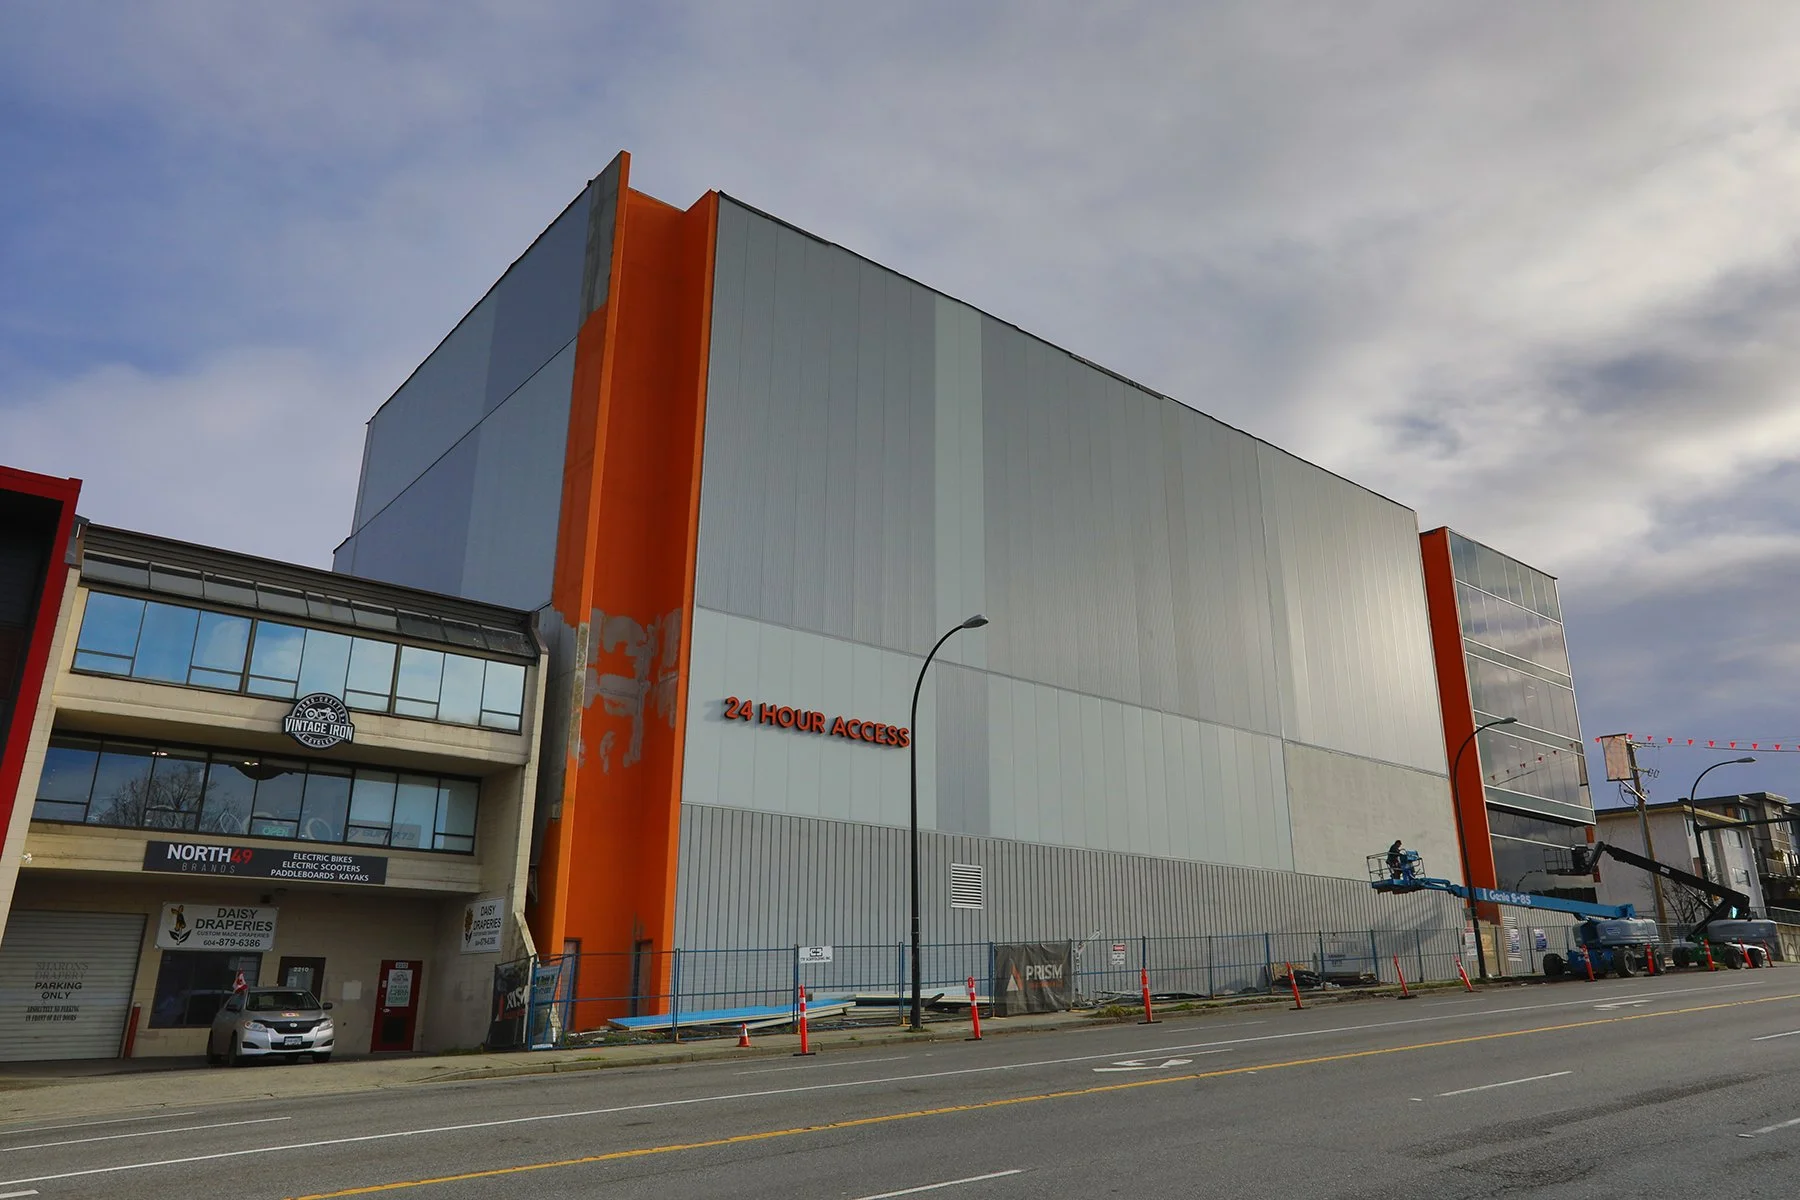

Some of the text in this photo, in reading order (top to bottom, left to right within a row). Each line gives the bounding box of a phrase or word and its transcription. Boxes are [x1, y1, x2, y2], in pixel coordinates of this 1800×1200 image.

[725, 696, 910, 747] 24 HOUR ACCESS
[285, 718, 354, 741] VINTAGE IRON
[263, 824, 289, 837] OPEN
[362, 829, 416, 841] SUPR73
[166, 843, 254, 865] NORTH49
[293, 852, 353, 864] ELECTRIC BIKES
[181, 863, 236, 874] BRANDS
[282, 860, 361, 873] ELECTRIC SCOOTERS
[270, 869, 369, 882] PADDLEBOARDS KAYAKS
[1489, 890, 1532, 905] Genie S-85
[217, 908, 258, 919] DAISY
[481, 904, 497, 917] DAISY
[195, 918, 273, 932] DRAPERIES
[473, 917, 502, 931] DRAPERIES
[203, 938, 261, 948] 604-879-6386
[1025, 963, 1063, 981] PRISM
[34, 982, 83, 990] PARKING
[41, 991, 71, 999] ONLY
